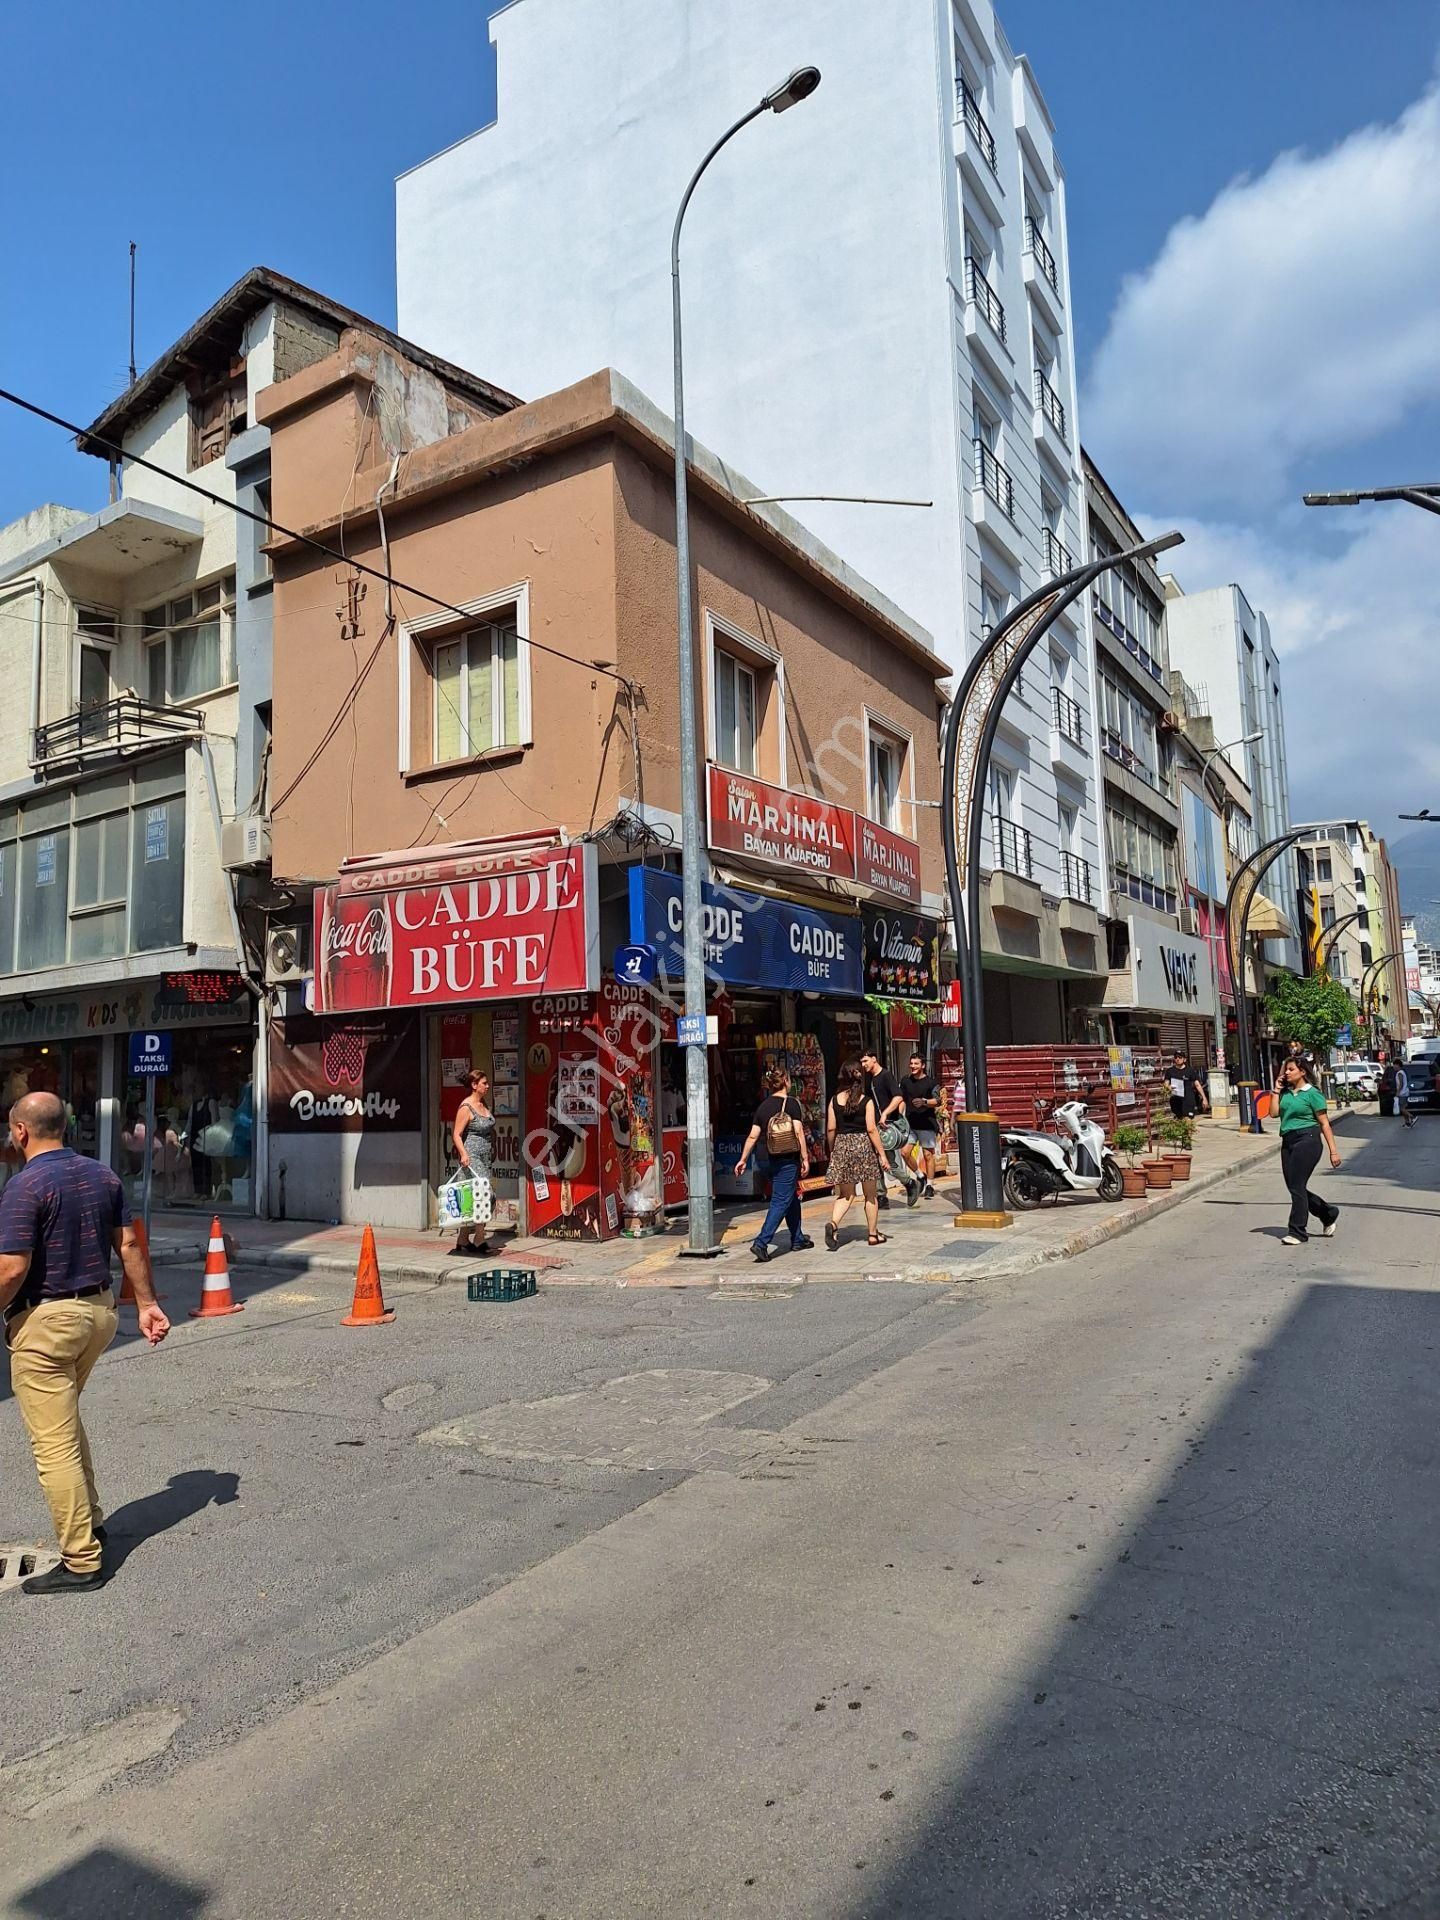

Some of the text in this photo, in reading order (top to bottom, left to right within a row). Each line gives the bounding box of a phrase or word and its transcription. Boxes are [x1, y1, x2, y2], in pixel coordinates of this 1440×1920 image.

[728, 779, 757, 800] Salon
[728, 794, 844, 850] MARJİNAL
[744, 833, 831, 869] BAYAN KUAFÖRÜ
[863, 836, 916, 880] MARJİNAL
[351, 864, 441, 891] CADDE
[394, 858, 580, 931] CADDE
[326, 908, 389, 956] Coca-Cola
[667, 896, 744, 944] CDDE
[702, 940, 724, 964] ÜFE
[789, 922, 845, 962] CADDE
[873, 918, 923, 964] Vitamin
[409, 928, 548, 996] BÜFE
[625, 956, 642, 975] +1
[807, 959, 831, 979] BÜFE
[531, 995, 589, 1015] CADDE
[603, 984, 645, 1002] CADDE
[87, 1002, 119, 1028] KIDS
[610, 1001, 641, 1021] BÜFE
[539, 1014, 581, 1034] BÜFE
[144, 1034, 161, 1053] D
[133, 1063, 169, 1073] DURAĞI
[138, 1054, 165, 1063] TAKSİ
[290, 1089, 401, 1121] Butterfly
[718, 1143, 742, 1154] Erikli
[546, 1228, 581, 1239] MAGNUM
